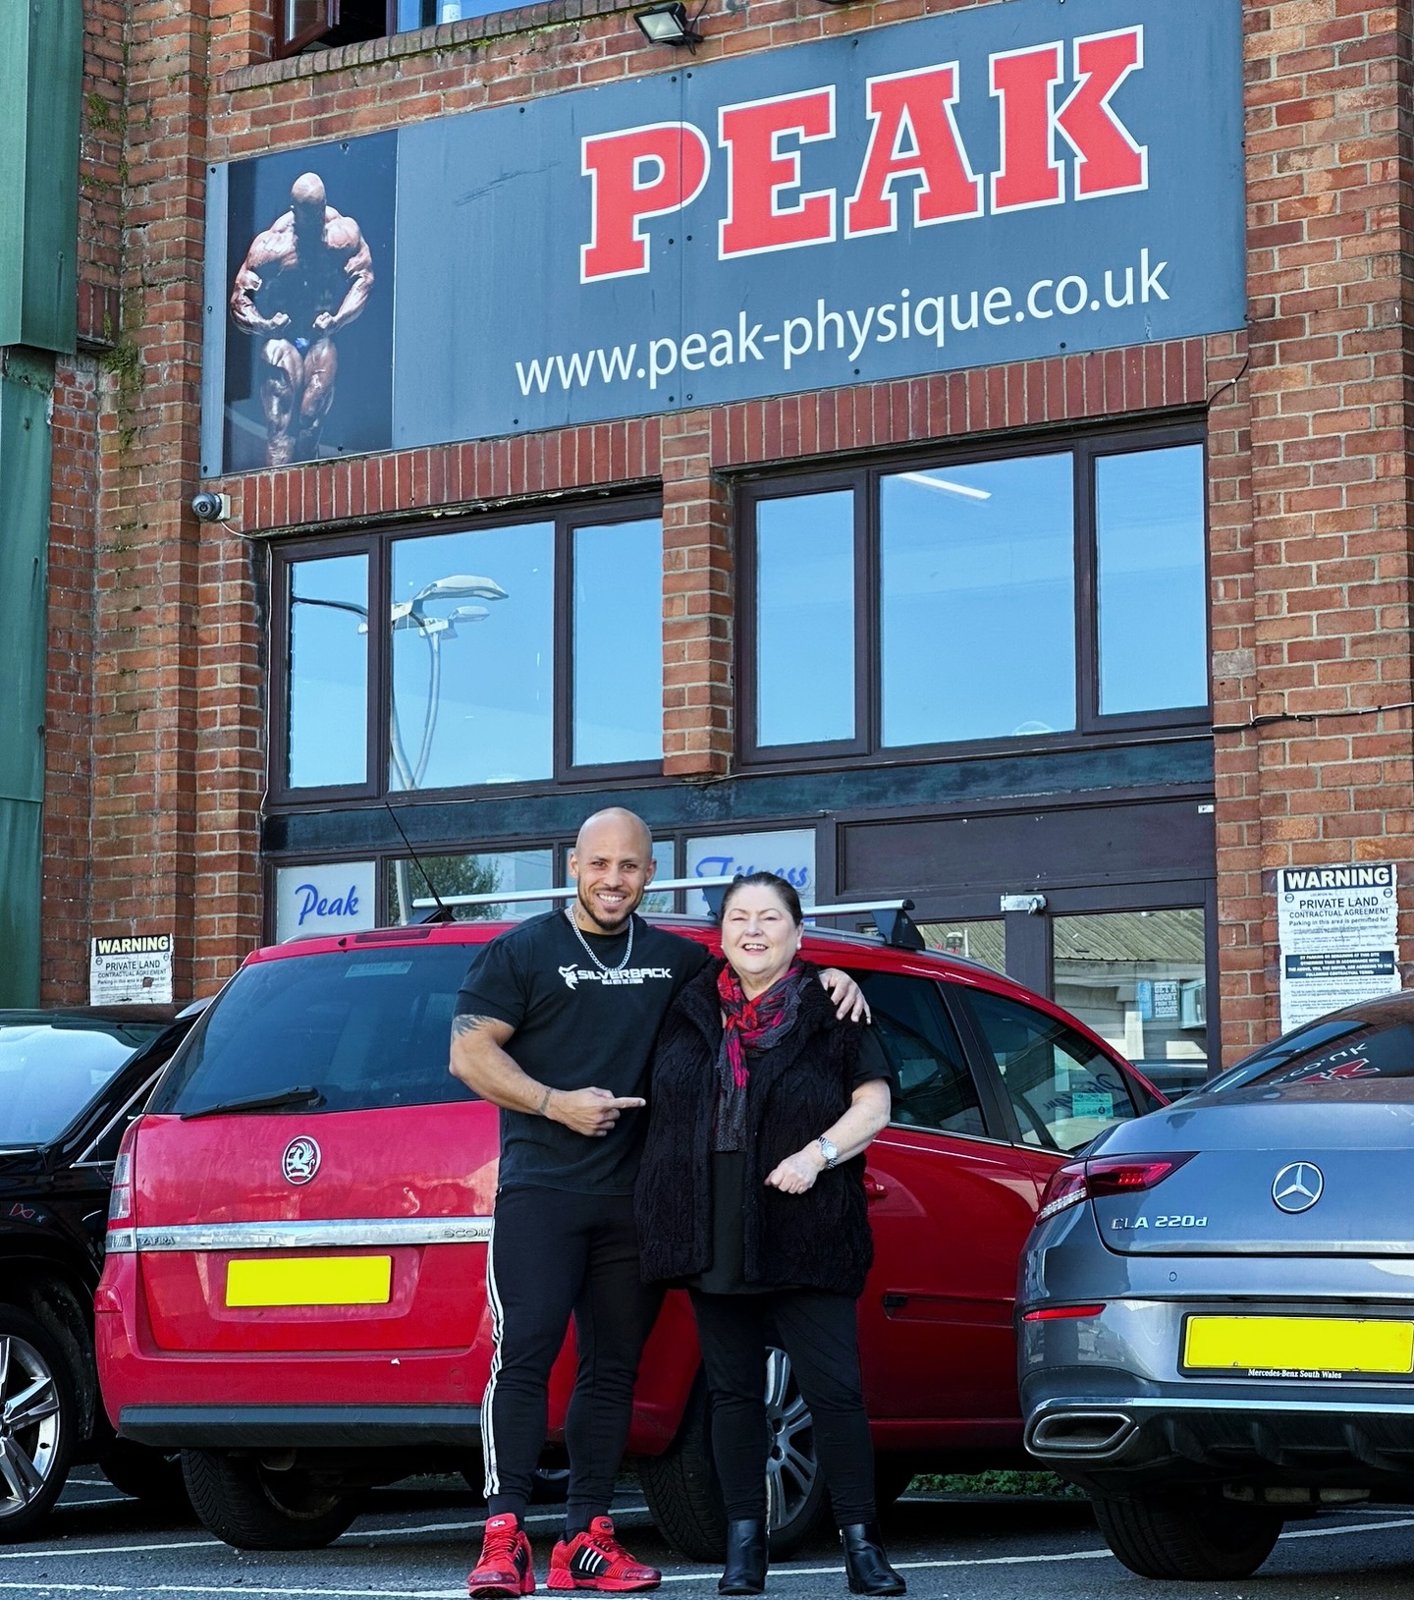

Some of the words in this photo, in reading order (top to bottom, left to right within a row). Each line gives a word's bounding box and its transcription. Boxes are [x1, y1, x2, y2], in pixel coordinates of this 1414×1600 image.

[580, 24, 1149, 284] PEAK
[515, 248, 1169, 394] www.peak-physique.co.uk
[1286, 867, 1390, 890] WARNING
[294, 883, 359, 926] Peak
[1299, 898, 1345, 909] PRIVATE
[1348, 896, 1379, 907] LAND
[1289, 909, 1342, 918] CONTRACTUAL
[1344, 907, 1389, 916] AGREEMENT
[98, 936, 169, 954] WARNING
[105, 961, 137, 971] PRIVATE
[139, 960, 160, 969] LAND
[577, 968, 673, 980] SILVERBACK
[1111, 1216, 1149, 1229] CLA
[1154, 1215, 1208, 1228] 220d
[141, 1235, 176, 1246] ZAFIRA
[1247, 1368, 1299, 1378] Mercedes-Benz
[1299, 1370, 1321, 1379] South
[1321, 1371, 1342, 1379] Wales
